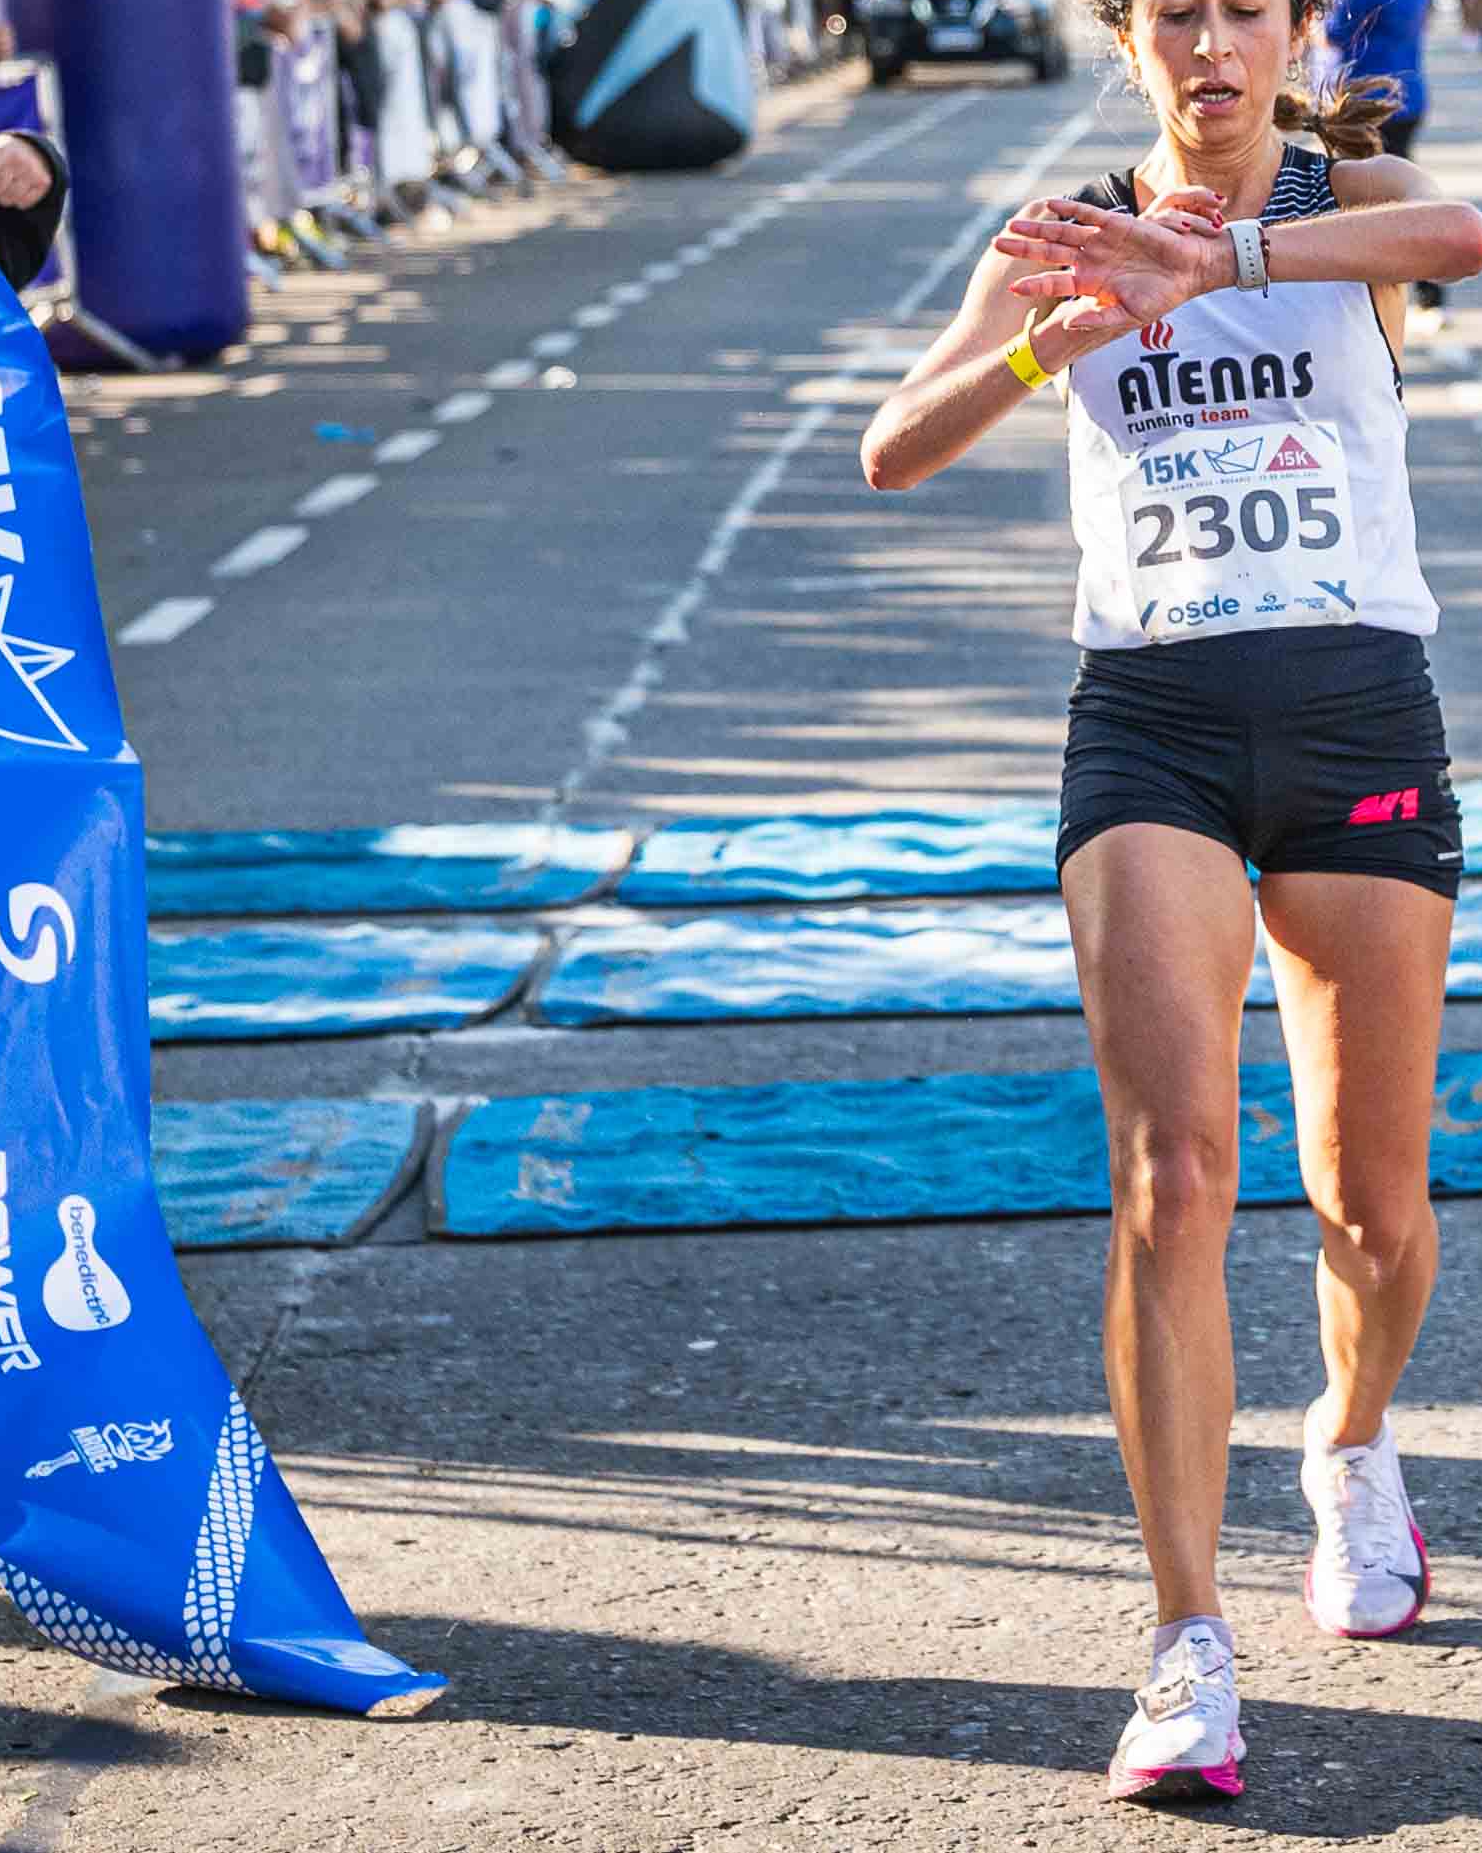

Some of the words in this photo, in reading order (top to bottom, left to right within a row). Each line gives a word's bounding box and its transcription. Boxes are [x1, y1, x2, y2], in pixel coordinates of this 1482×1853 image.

[1126, 410, 1195, 435] running
[1200, 406, 1250, 424] team
[1139, 449, 1201, 487] 15K
[1132, 486, 1342, 569] 2305
[1167, 593, 1242, 627] osde
